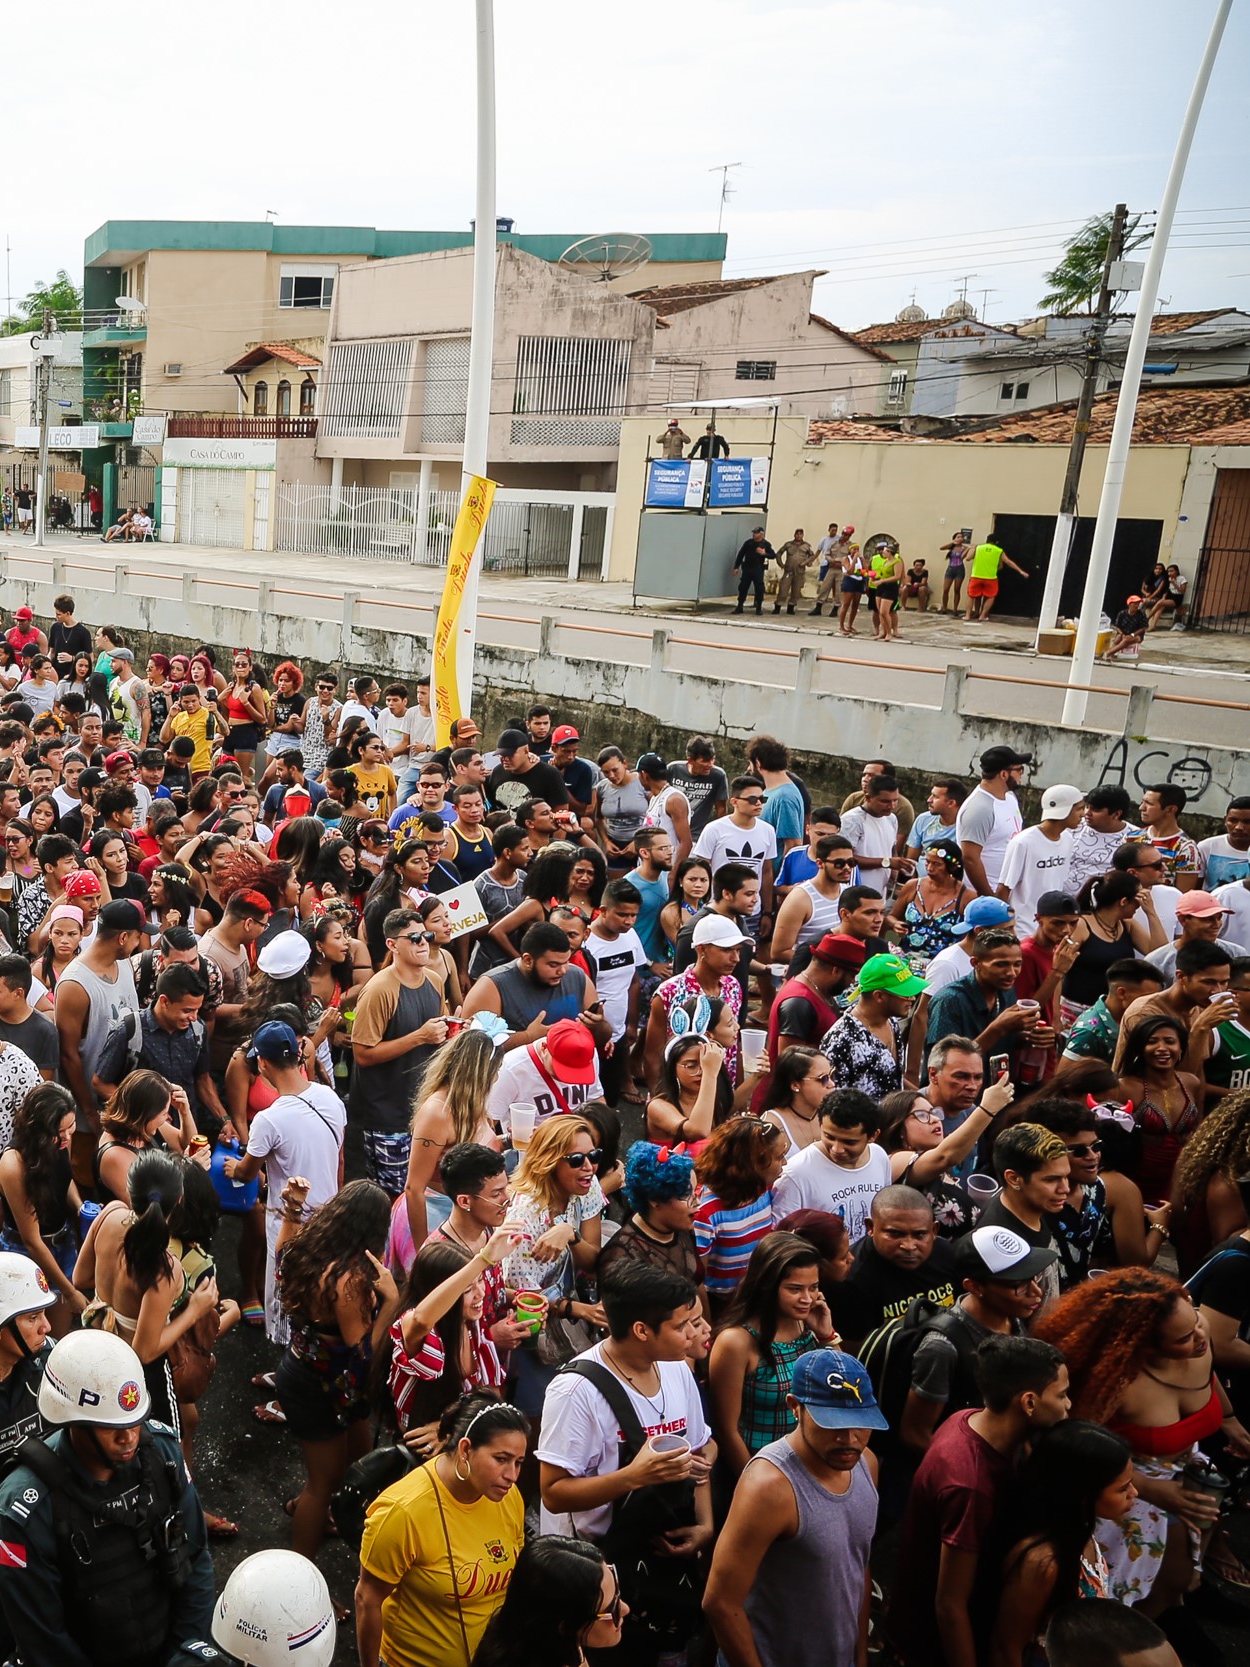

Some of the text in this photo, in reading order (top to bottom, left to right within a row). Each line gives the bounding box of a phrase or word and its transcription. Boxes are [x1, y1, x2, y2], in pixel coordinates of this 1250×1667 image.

[654, 469, 686, 477] SEGURANÇA
[717, 465, 745, 474] SEGURANÇA
[657, 476, 680, 484] PÚBLICA
[721, 473, 741, 482] PÚBLICA
[360, 782, 386, 790] ICKE
[672, 777, 713, 790] LOS ANGELES
[1036, 855, 1066, 869] adida
[451, 911, 487, 934] RVEJA
[831, 1185, 857, 1203] ROCK
[77, 1387, 101, 1407] P
[617, 1417, 687, 1441] TETHER
[444, 1547, 519, 1600] Due
[235, 1624, 268, 1643] MILITAR
